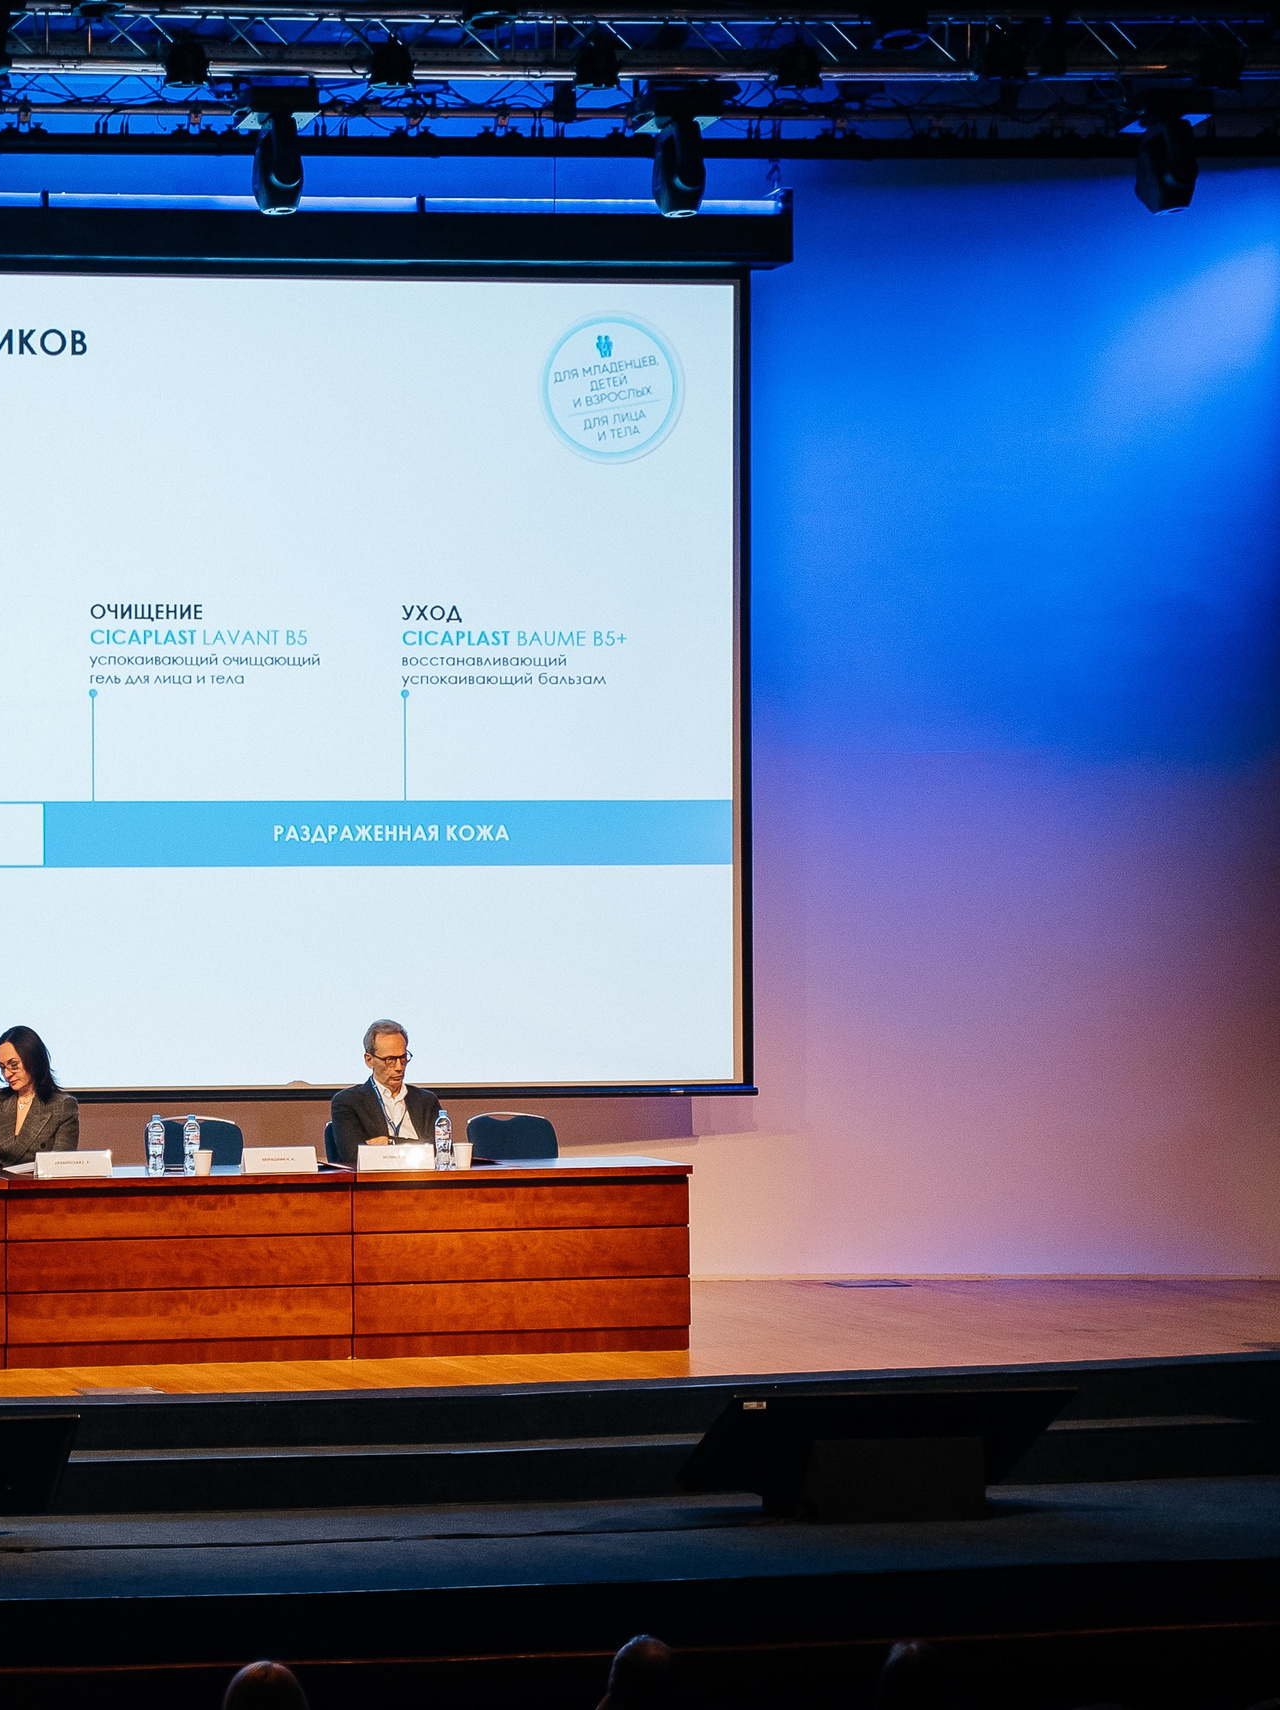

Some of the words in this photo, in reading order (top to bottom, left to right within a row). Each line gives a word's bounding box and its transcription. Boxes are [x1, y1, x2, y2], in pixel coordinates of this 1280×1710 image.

[554, 369, 579, 384] ДЛЯ
[590, 374, 628, 392] ДЕТЕЙ
[573, 398, 582, 408] И
[585, 386, 652, 407] ВЗРОСЛЫХ
[583, 416, 609, 430] ДЛЯ
[613, 410, 646, 425] ЛИЦА
[597, 431, 606, 441] И
[610, 425, 640, 439] ТЕЛА
[90, 603, 203, 622] ОЧИЩЕНИЕ
[401, 604, 463, 623] УХОД
[89, 629, 197, 645] CICAPLAST
[202, 629, 280, 646] LAVANT
[285, 629, 308, 646] B5
[401, 630, 510, 647] CICAPLAST
[517, 630, 587, 647] BAUME
[593, 630, 628, 647] B5+
[89, 653, 219, 669] успокаивающий
[222, 653, 321, 668] очищающий
[401, 653, 567, 669] восстанавливающий
[89, 674, 122, 685] гель
[124, 674, 150, 686] для
[153, 674, 193, 686] лица
[196, 674, 206, 685] и
[210, 674, 245, 685] тела
[400, 672, 533, 687] успокаивающий
[538, 672, 607, 686] бальзам
[273, 824, 440, 844] РАЗДРАЖЕННАЯ
[446, 824, 510, 841] КОЖА
